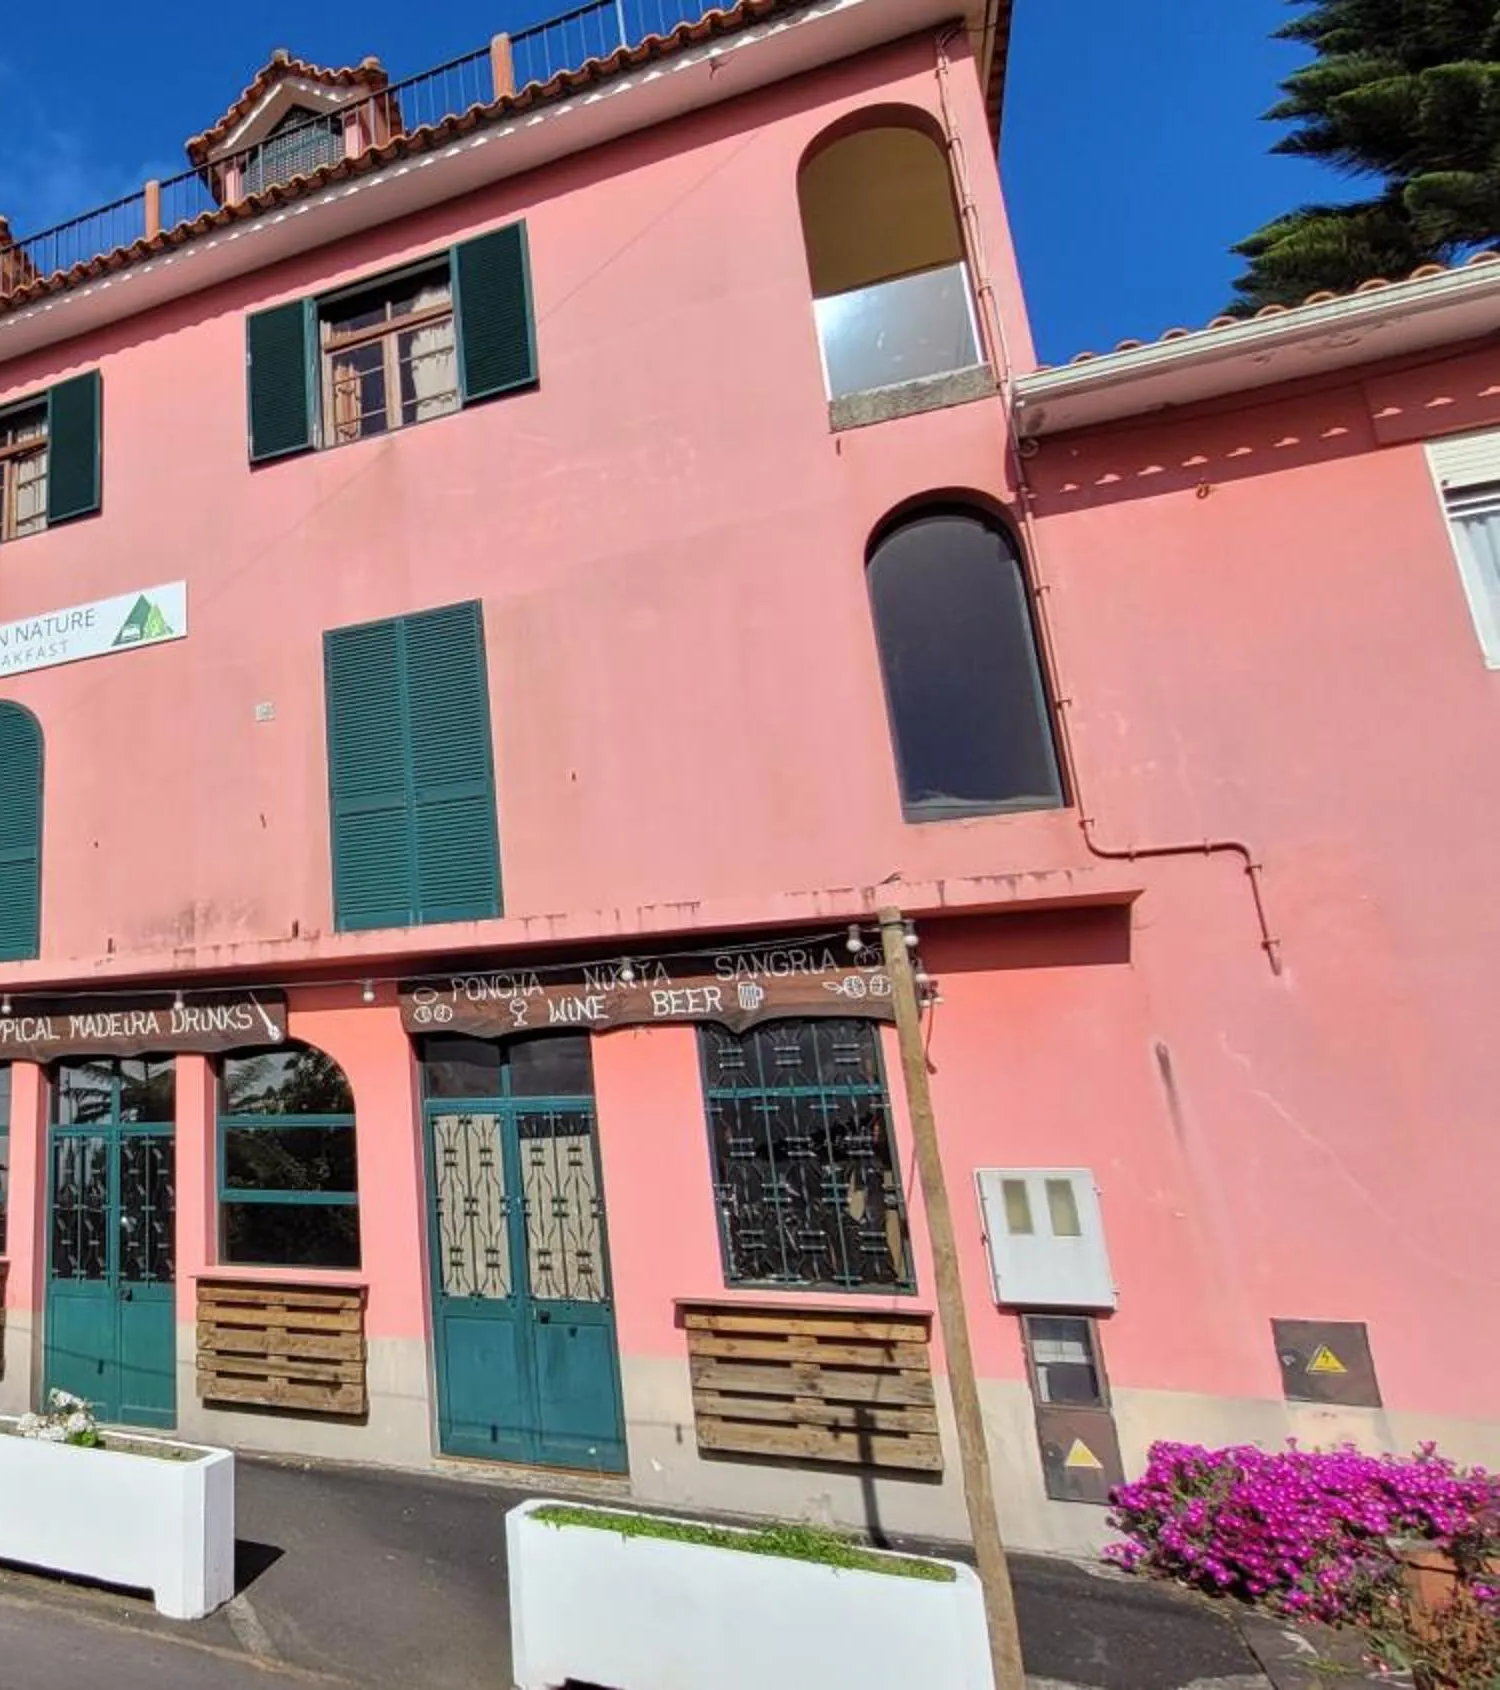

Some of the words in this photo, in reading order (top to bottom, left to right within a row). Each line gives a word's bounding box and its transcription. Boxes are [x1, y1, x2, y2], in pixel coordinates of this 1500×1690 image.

[14, 608, 97, 642] NATURE
[451, 972, 545, 1002] PONCHA
[652, 986, 724, 1018] BEER
